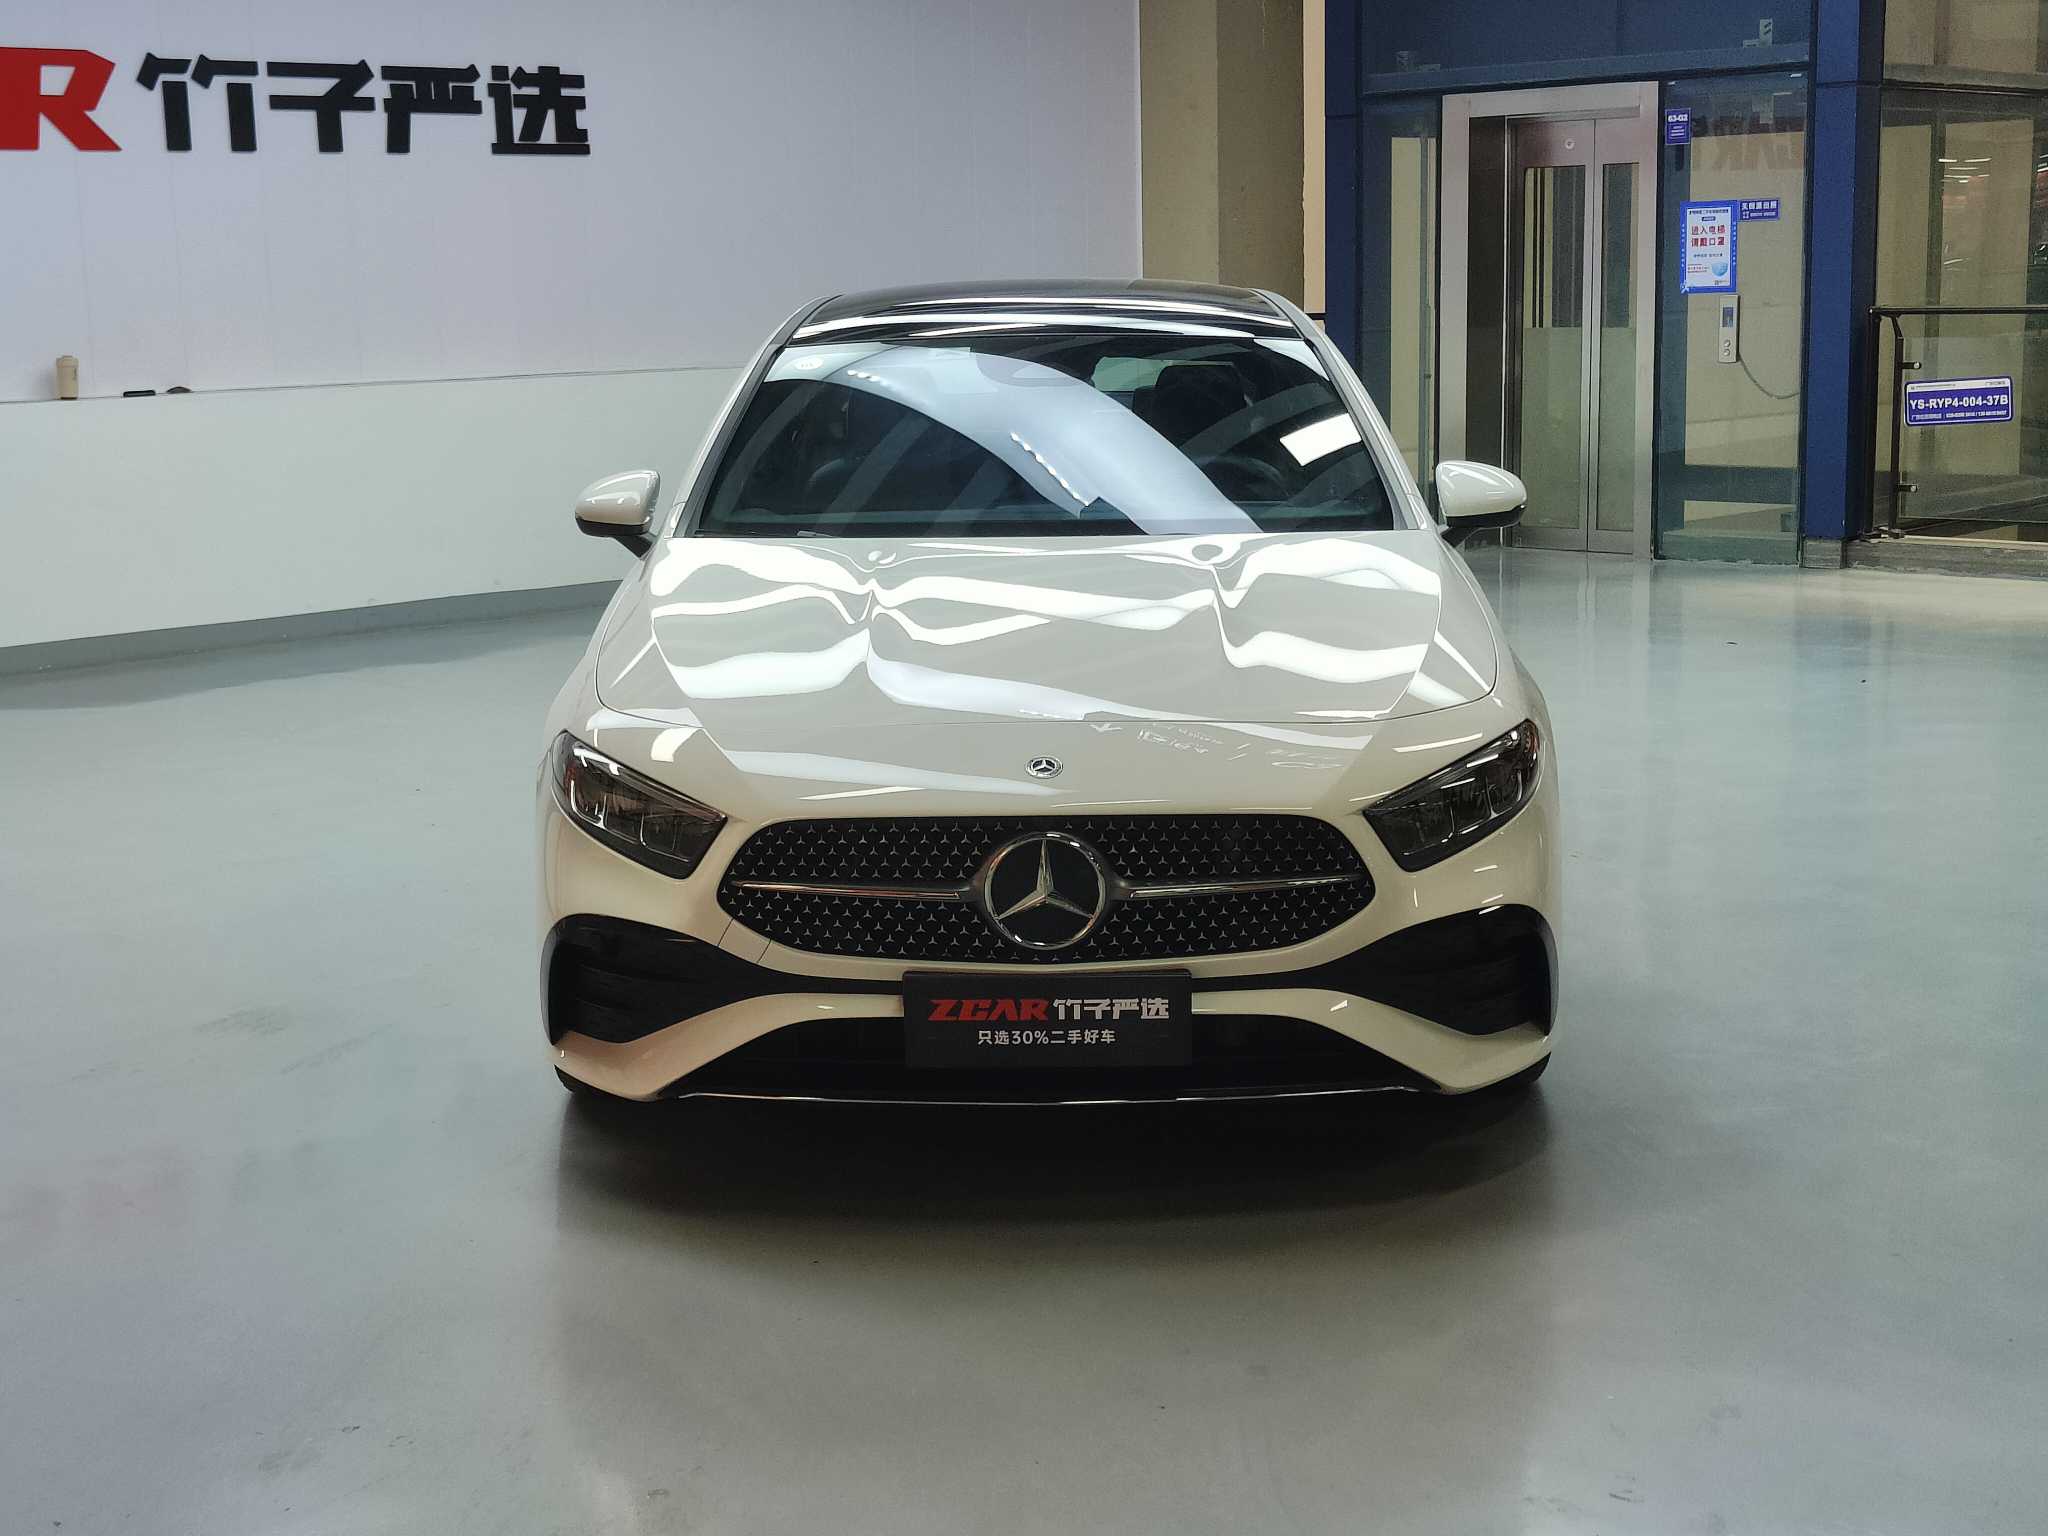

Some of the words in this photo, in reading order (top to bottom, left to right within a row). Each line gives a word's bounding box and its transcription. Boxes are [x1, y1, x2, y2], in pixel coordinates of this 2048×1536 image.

[135, 52, 591, 155] 竹子严选
[1691, 224, 1726, 235] 进入电梯
[1691, 236, 1725, 247] 请戴口罩
[1909, 394, 2009, 410] YS-RYP4-004-37B
[927, 998, 1050, 1021] ZCAR
[1053, 997, 1170, 1020] 竹子严选
[977, 1029, 1116, 1045] 只选30%二手好车
